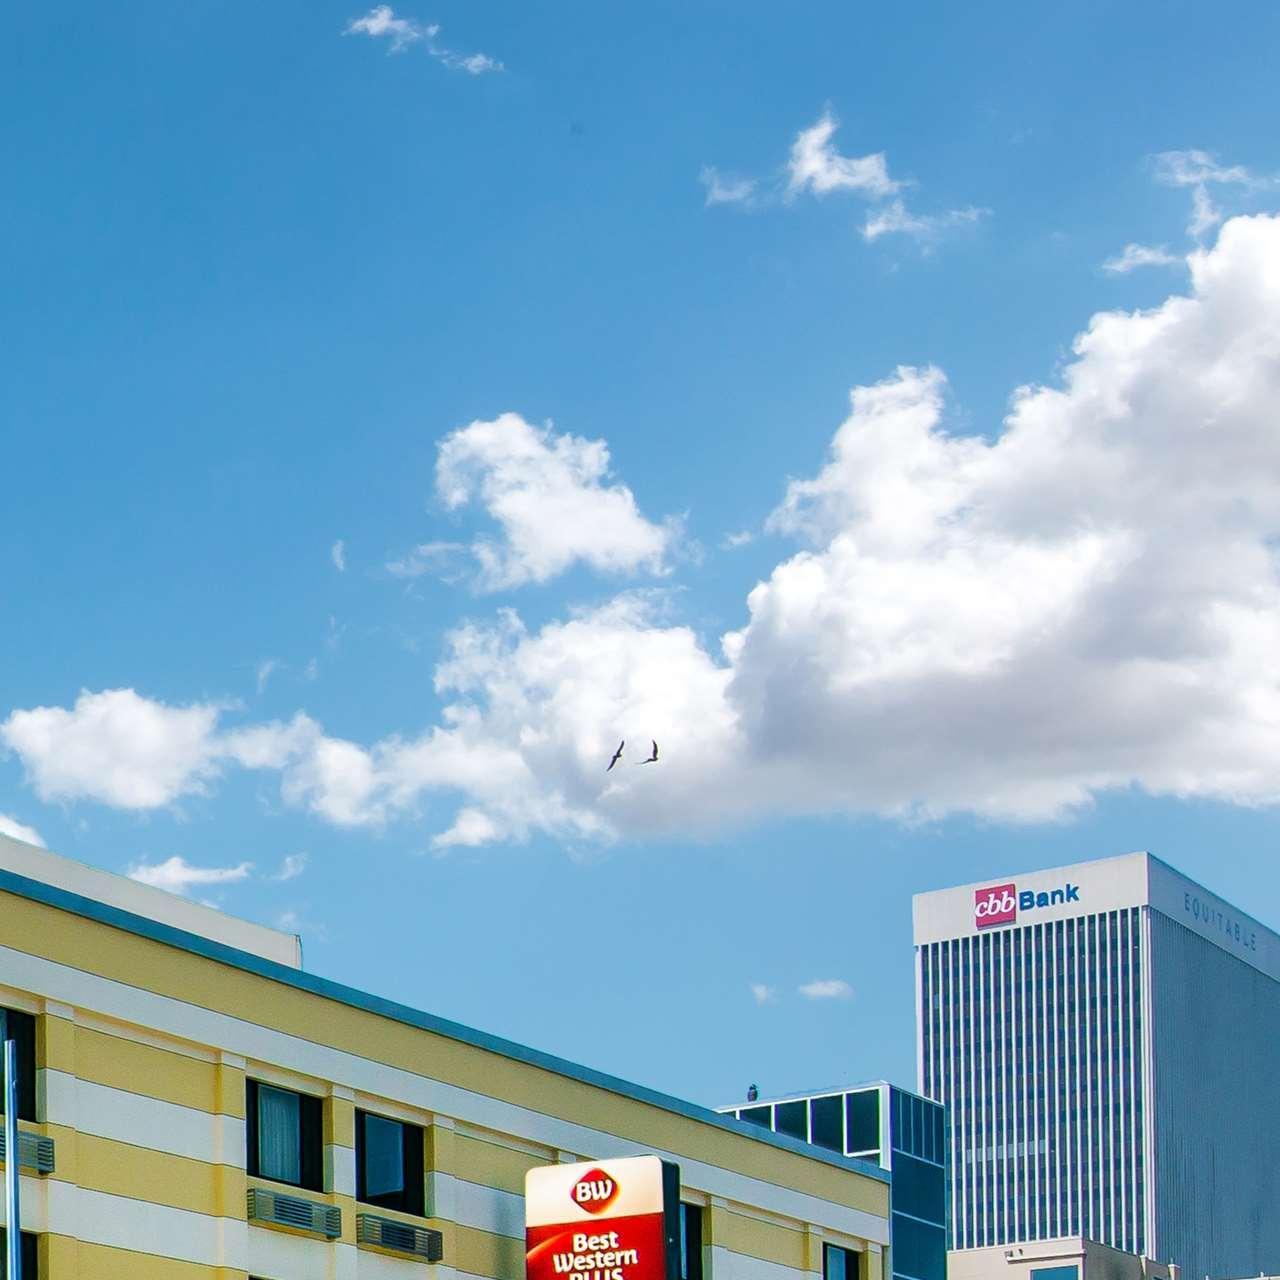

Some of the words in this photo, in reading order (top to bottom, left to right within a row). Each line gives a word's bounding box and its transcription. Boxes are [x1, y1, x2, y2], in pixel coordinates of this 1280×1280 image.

[975, 890, 1015, 917] cbb
[1019, 883, 1080, 911] Bank
[1184, 891, 1256, 952] EQUITABLE
[576, 1179, 613, 1202] BW
[573, 1231, 619, 1252] Best
[553, 1248, 638, 1273] Western
